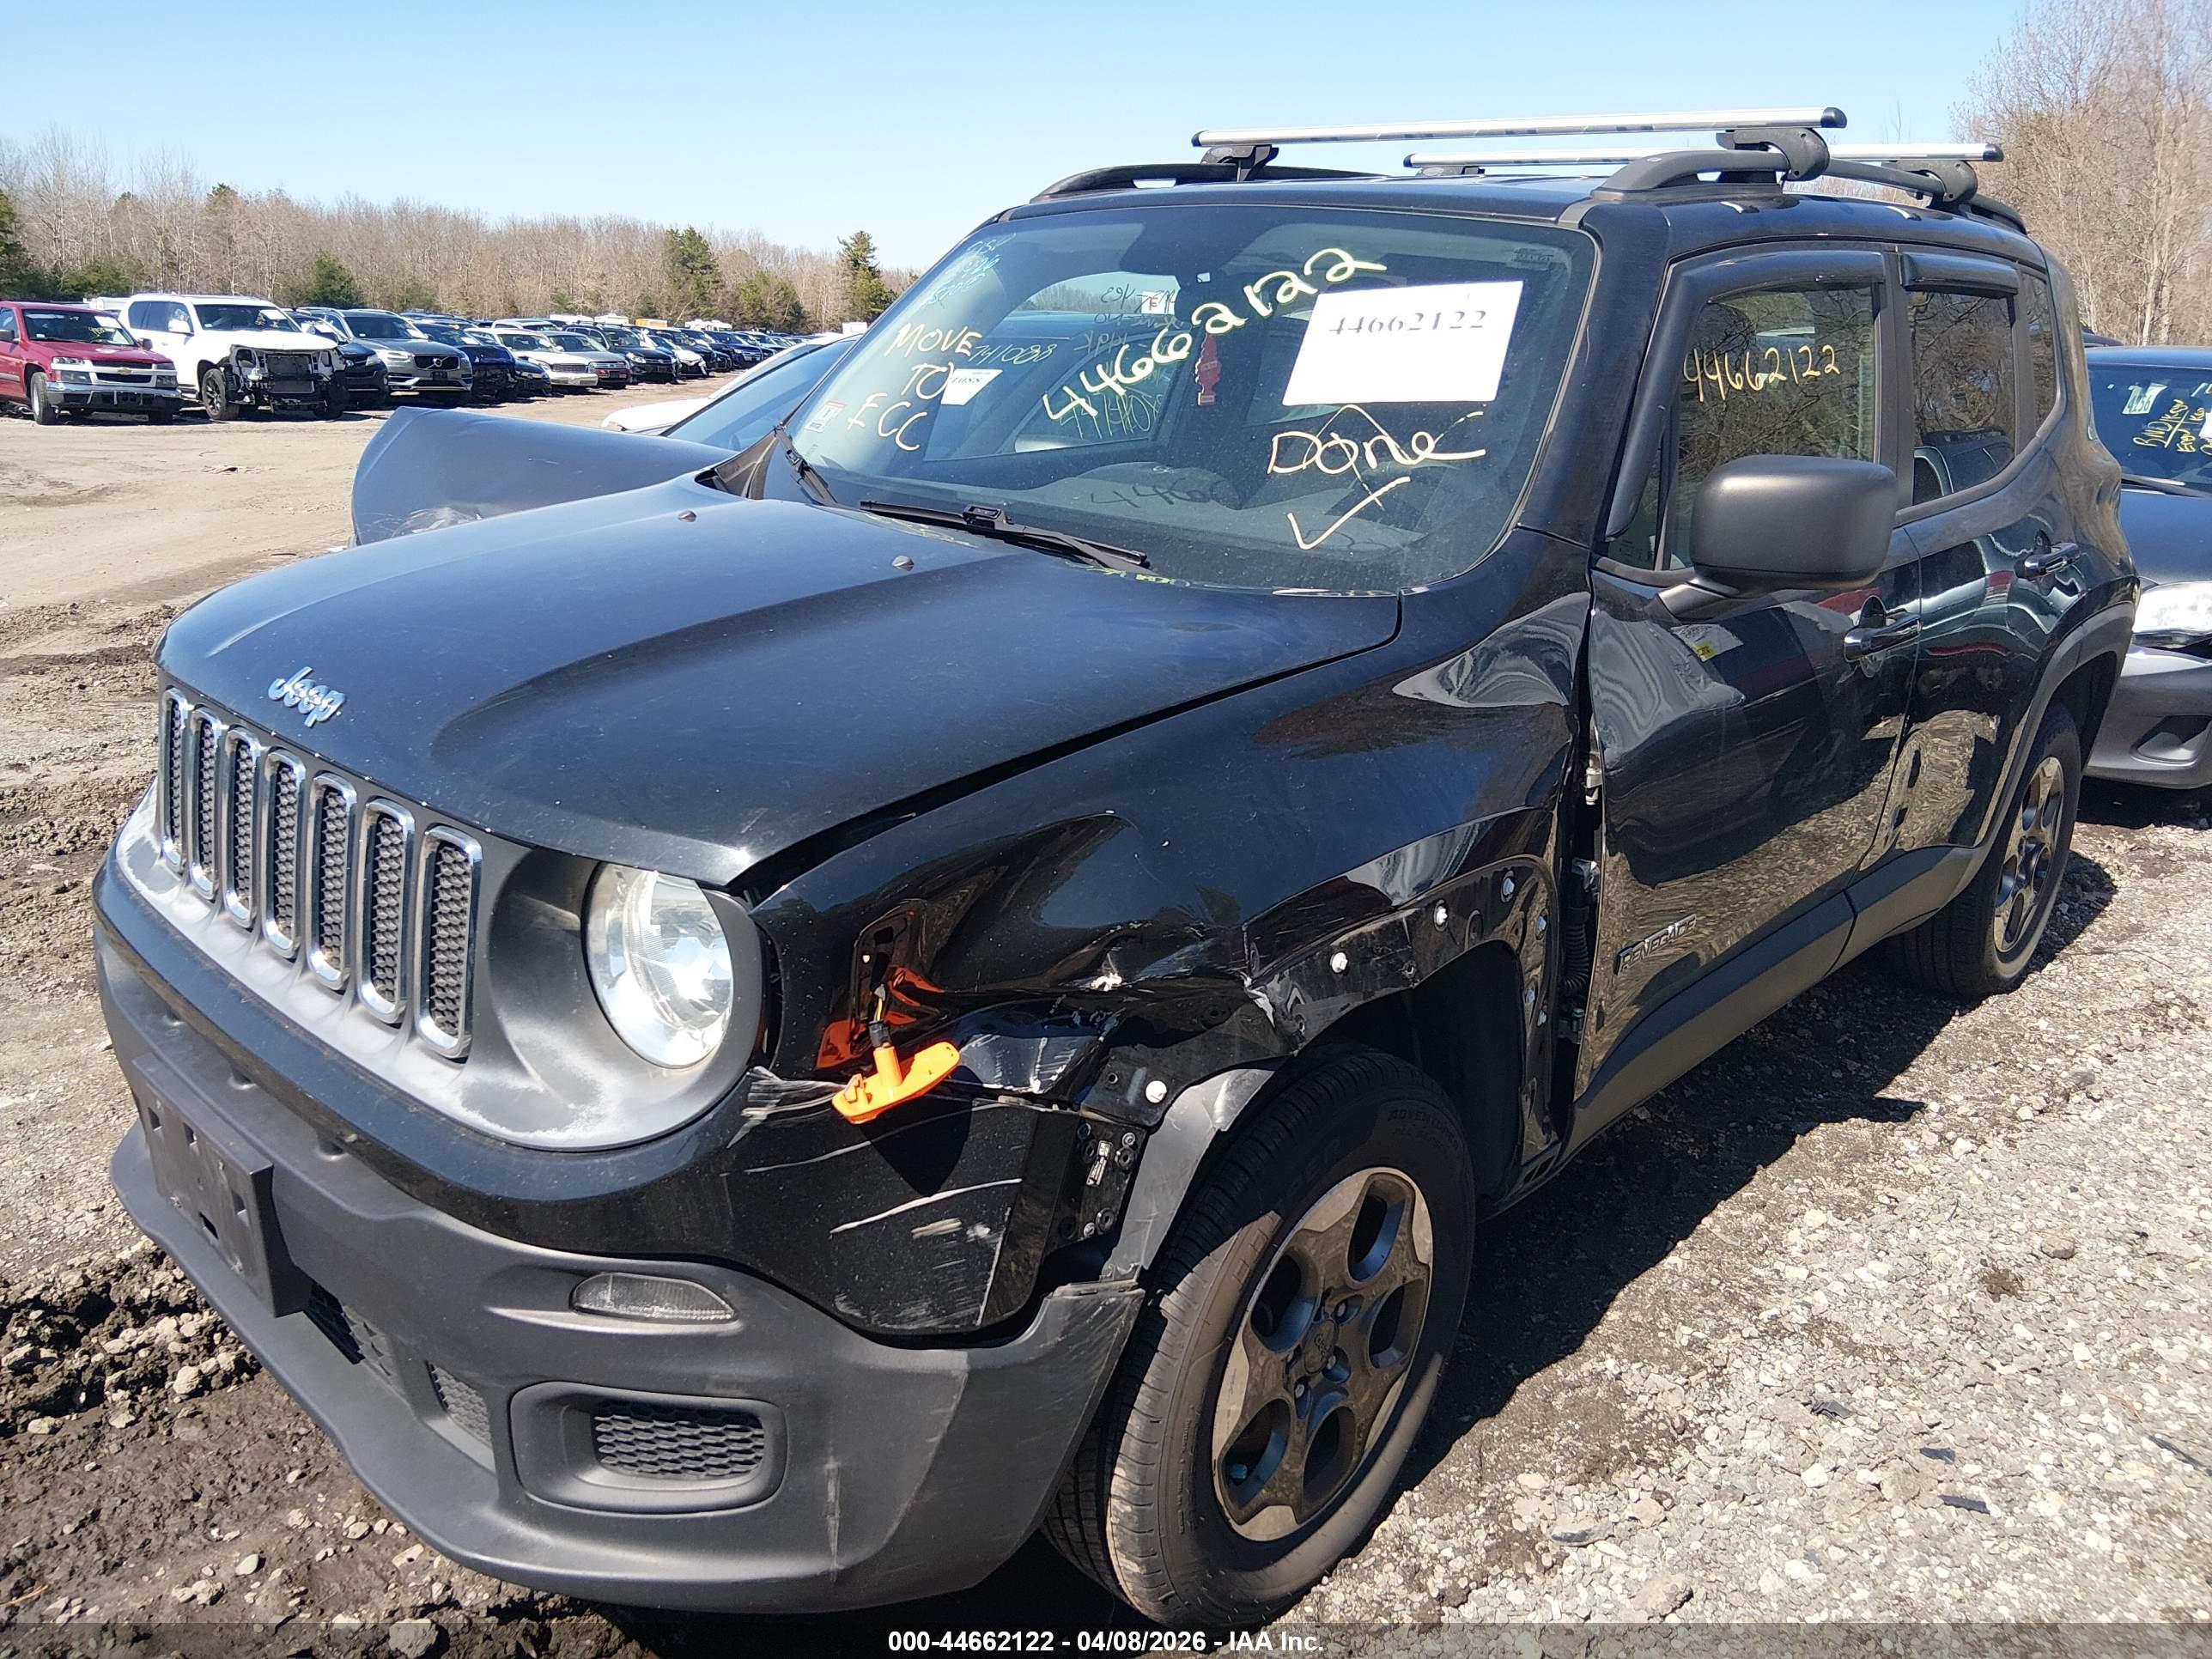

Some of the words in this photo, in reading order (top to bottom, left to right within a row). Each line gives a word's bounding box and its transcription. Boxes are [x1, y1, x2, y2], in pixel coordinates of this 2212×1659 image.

[884, 323, 983, 357] MOVE
[1042, 248, 1387, 420] 44662122
[1328, 310, 1486, 335] 44662122
[901, 362, 955, 400] TO
[1267, 430, 1486, 474] Done
[268, 665, 346, 728] Jeep
